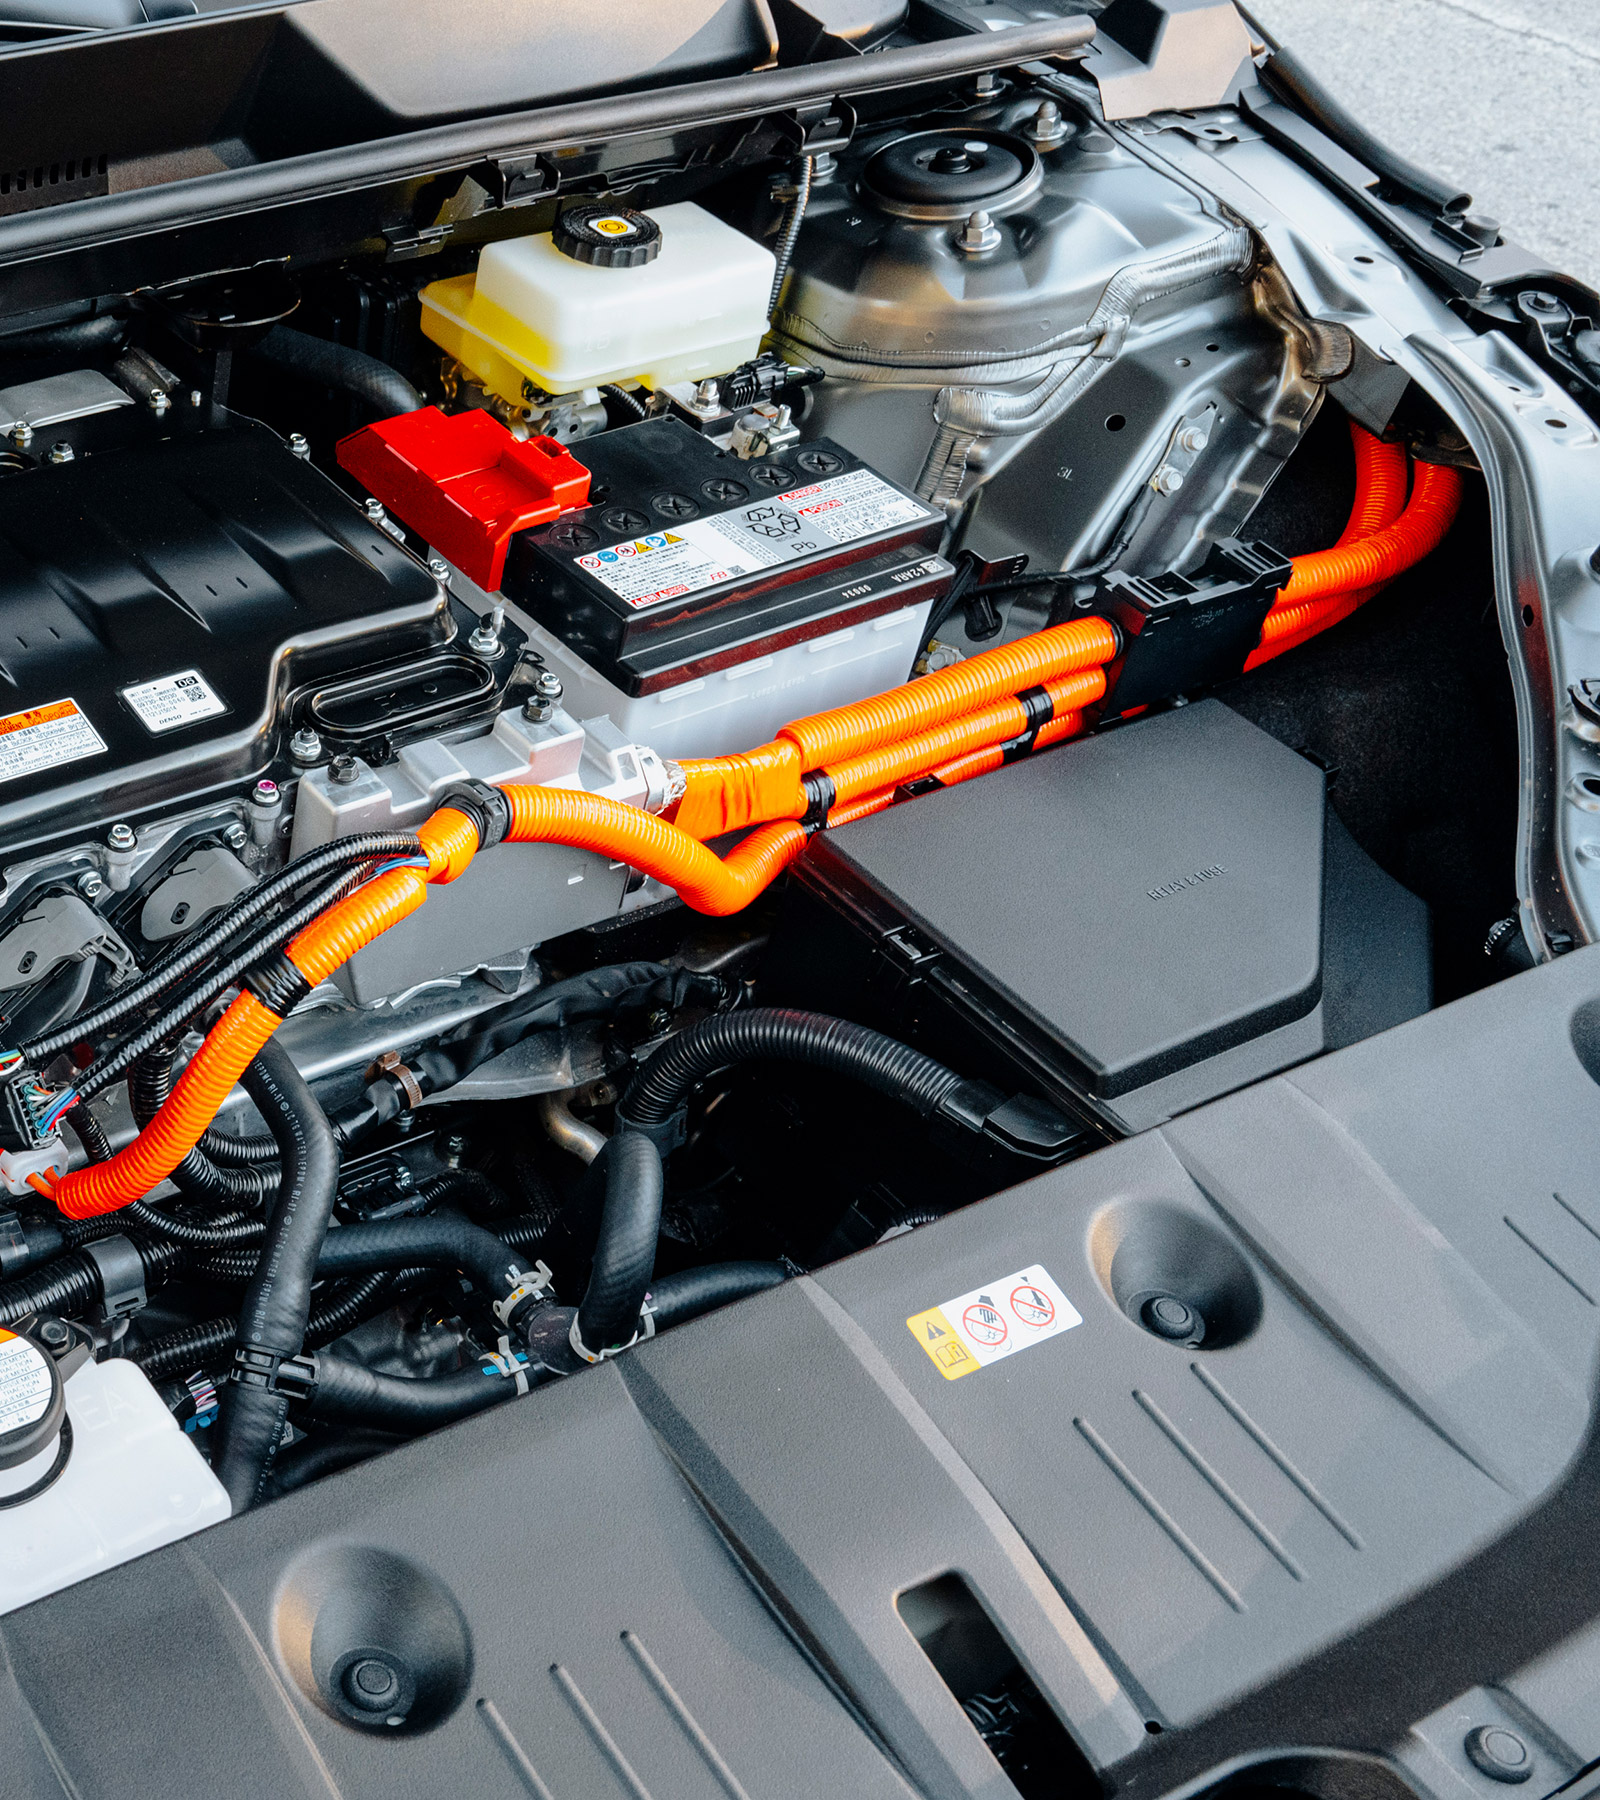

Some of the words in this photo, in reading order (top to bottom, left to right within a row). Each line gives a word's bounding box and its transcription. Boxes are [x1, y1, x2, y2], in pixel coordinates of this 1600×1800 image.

[808, 500, 842, 513] POISON
[791, 541, 817, 553] Pb
[177, 678, 196, 687] 06
[159, 715, 183, 724] DENSO
[1146, 879, 1187, 901] RELAY
[1184, 875, 1198, 887] &
[1194, 863, 1229, 882] FUSE
[295, 1131, 306, 1154] WATER
[4, 1379, 40, 1396] TRACTION
